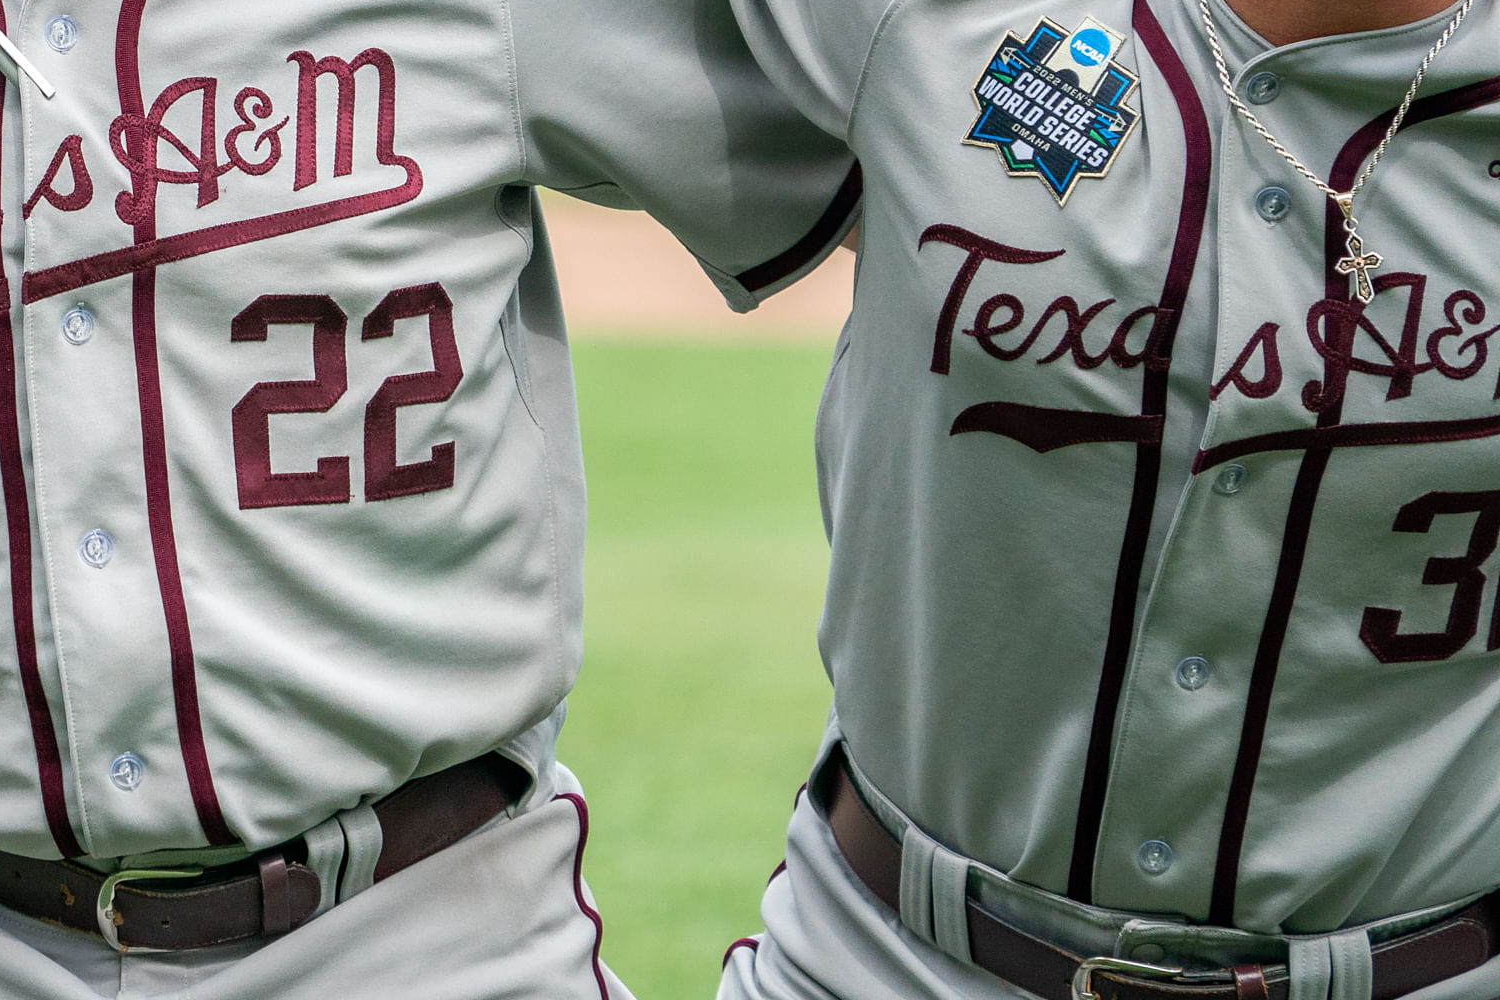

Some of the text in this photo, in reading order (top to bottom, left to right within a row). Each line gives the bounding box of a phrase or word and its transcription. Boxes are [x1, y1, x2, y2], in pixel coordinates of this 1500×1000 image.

[1032, 64, 1095, 107] 2022 MEN'S
[1072, 39, 1106, 64] NCAA
[109, 48, 424, 225] A&M
[977, 74, 1109, 168] WORLD SERIES
[1011, 122, 1052, 152] OMAHA
[1013, 70, 1097, 131] COLLEGE
[1301, 271, 1500, 413] A&
[230, 281, 464, 510] 22
[1358, 489, 1500, 665] 3
